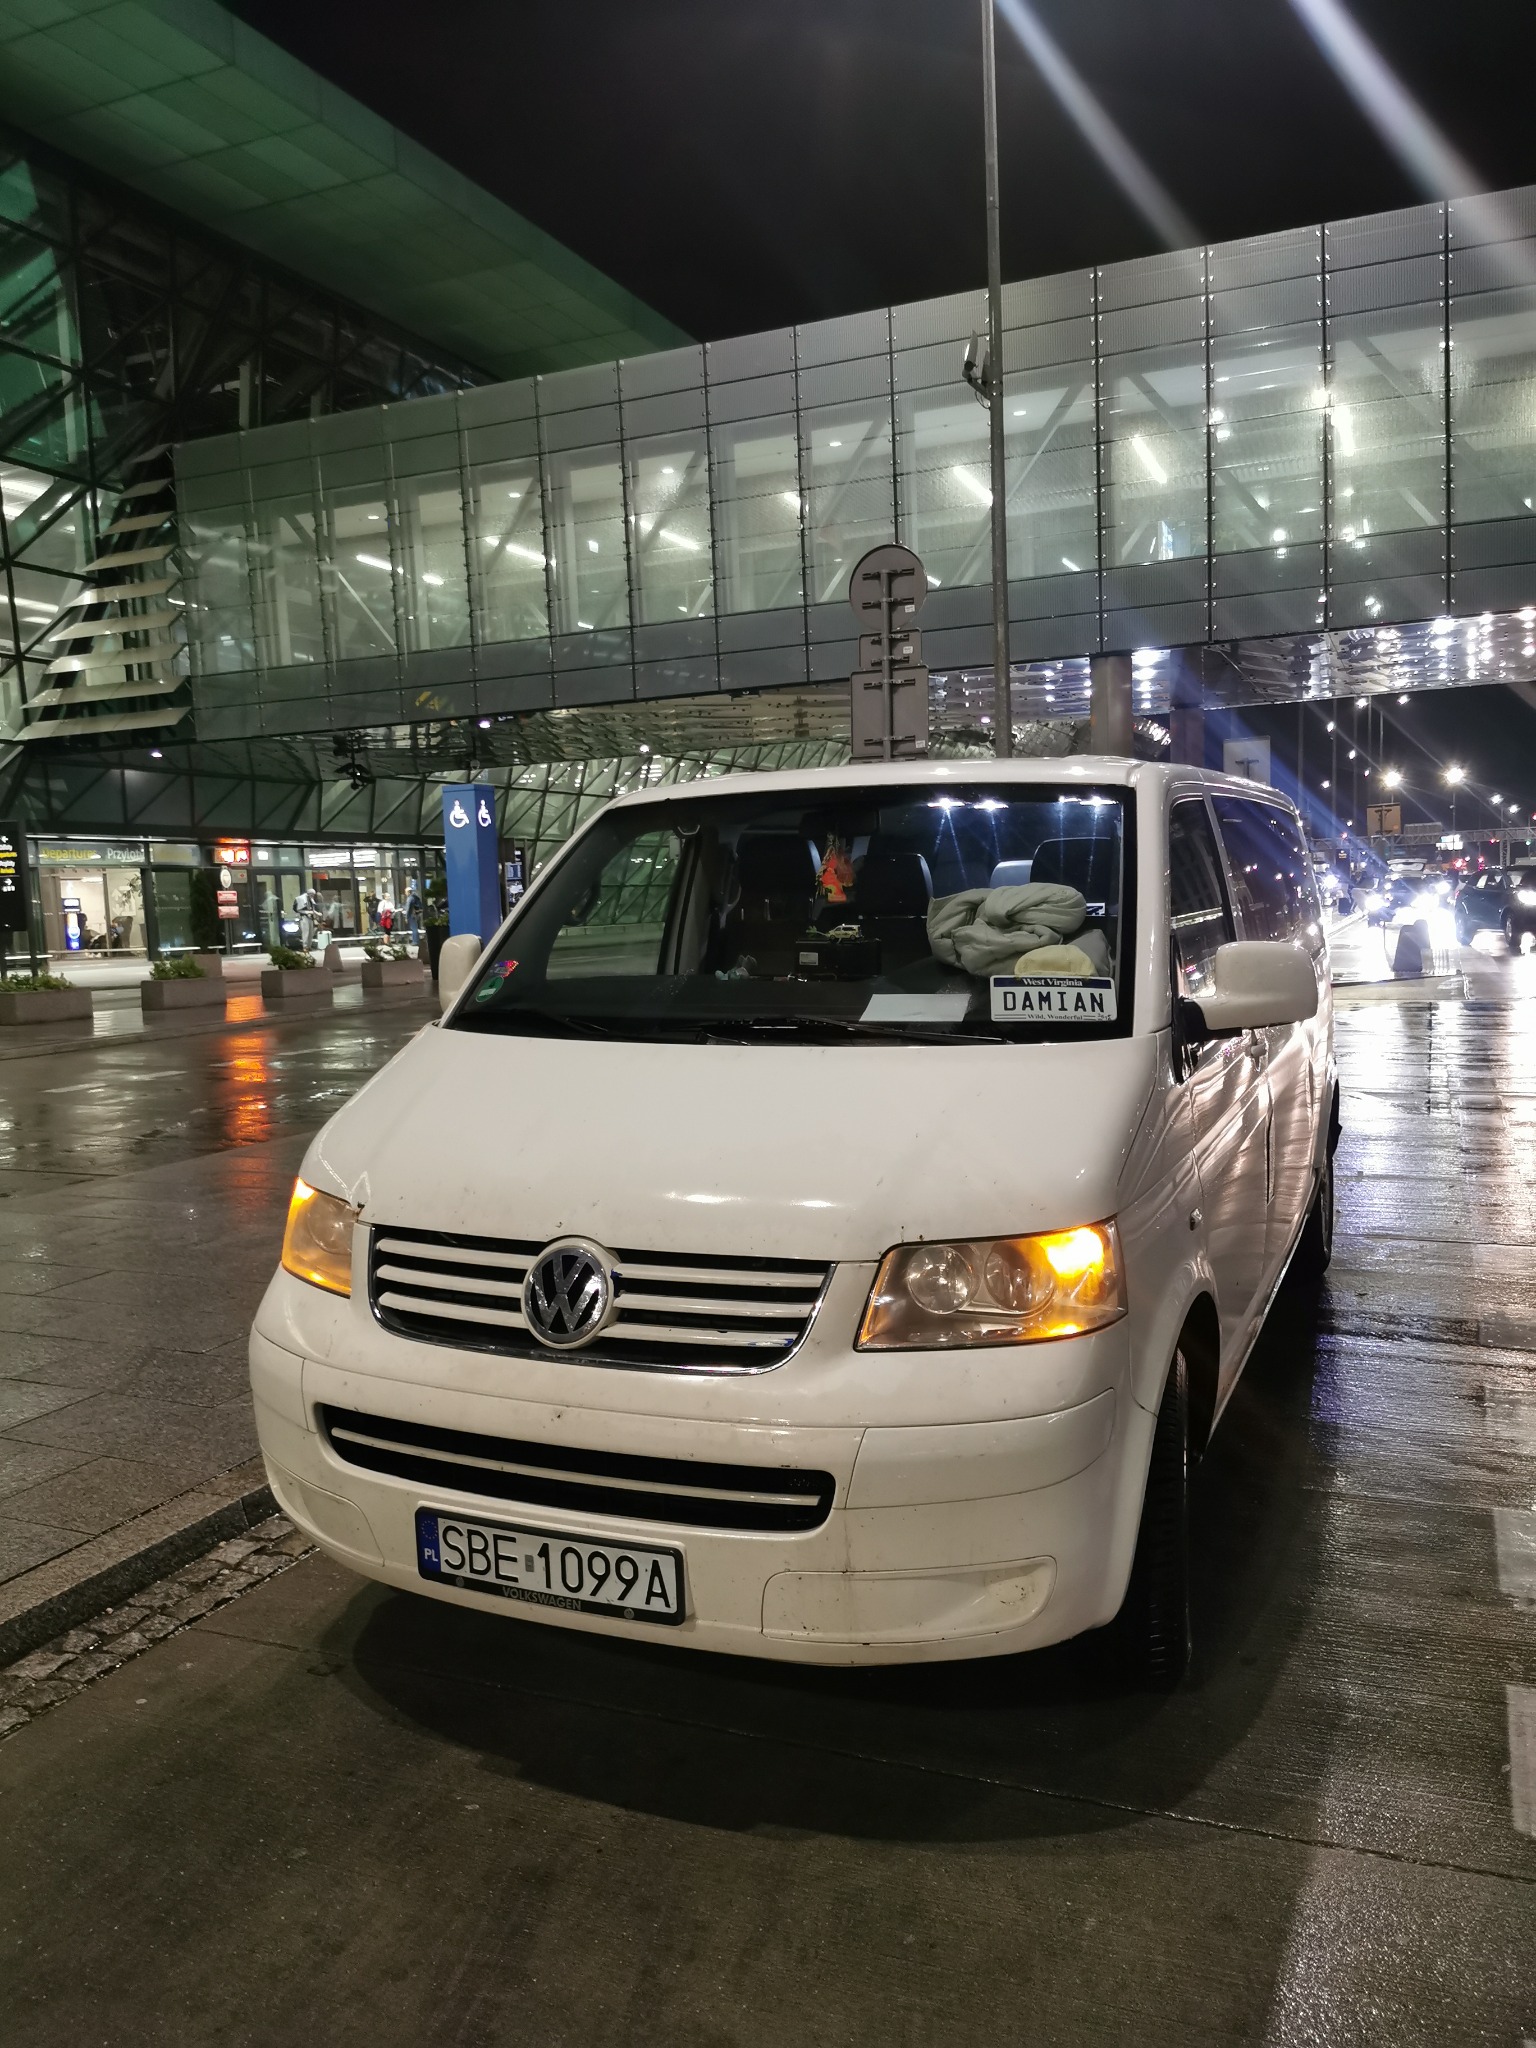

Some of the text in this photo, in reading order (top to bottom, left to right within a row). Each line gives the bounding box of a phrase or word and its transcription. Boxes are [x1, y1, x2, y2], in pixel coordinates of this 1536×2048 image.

[1047, 979, 1083, 987] Virginia
[1003, 991, 1104, 1013] DAMIAN
[424, 1548, 438, 1562] PL
[442, 1525, 671, 1609] SBE 1099A
[502, 1586, 582, 1611] VOLKSWAGEN
